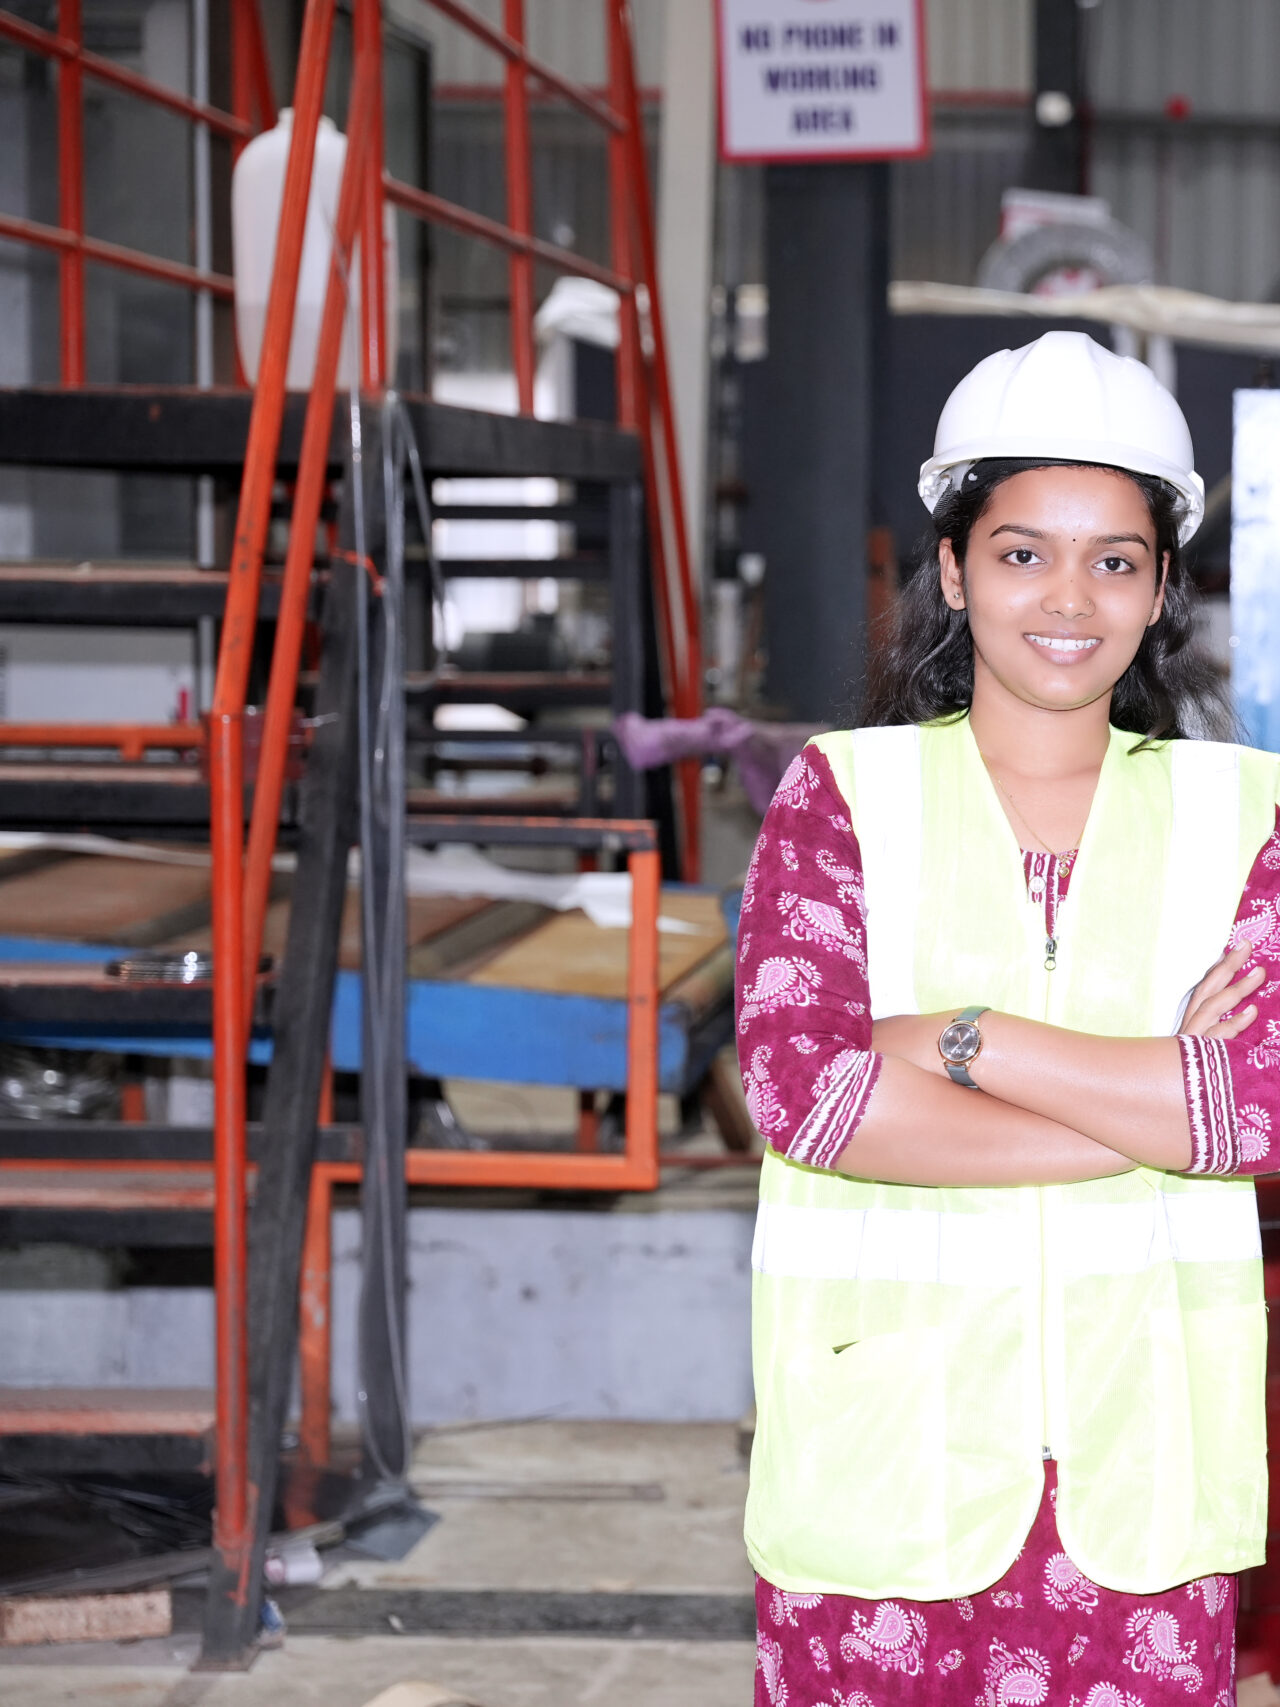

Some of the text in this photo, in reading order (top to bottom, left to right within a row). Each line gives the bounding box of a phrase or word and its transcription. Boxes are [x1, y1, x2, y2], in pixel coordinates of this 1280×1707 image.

[742, 23, 899, 50] NO PHONE IN
[764, 66, 879, 91] WORKING
[793, 107, 853, 132] AREA
